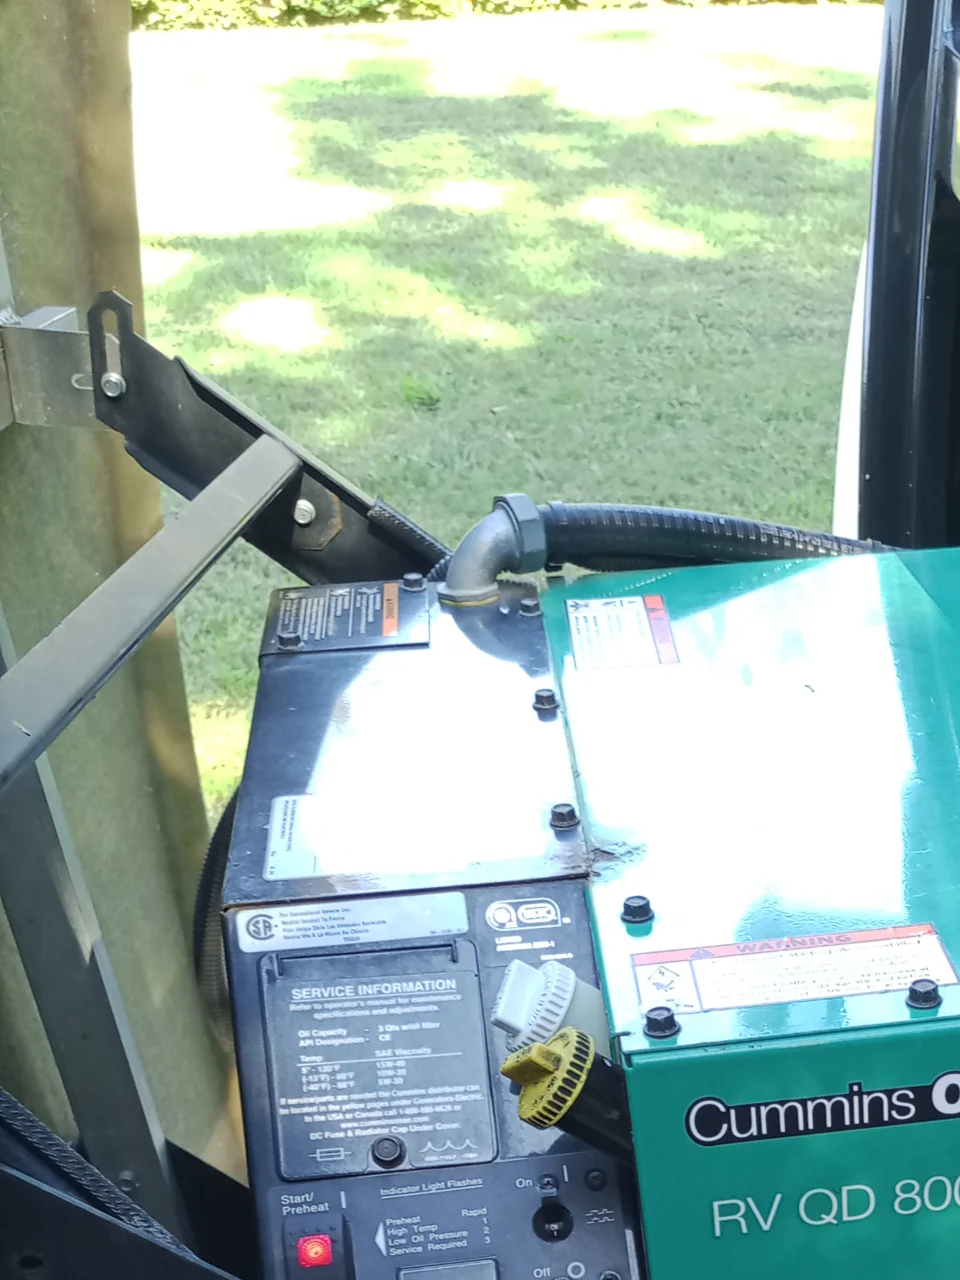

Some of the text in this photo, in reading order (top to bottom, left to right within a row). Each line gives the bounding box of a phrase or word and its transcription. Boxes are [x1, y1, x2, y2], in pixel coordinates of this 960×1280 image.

[736, 934, 852, 953] WARNING
[291, 979, 457, 1000] SERVICE INFORMATION
[289, 1003, 312, 1011] Refer
[323, 1000, 365, 1010] operator's
[366, 998, 397, 1006] manual
[410, 994, 462, 1003] maintenance
[313, 1009, 371, 1020] specifications
[371, 1007, 388, 1016] and
[298, 1029, 311, 1037] Oil
[311, 1028, 348, 1037] Capacity
[298, 1038, 314, 1047] API
[315, 1036, 365, 1046] Designation
[378, 1033, 392, 1041] CE
[299, 1046, 433, 1063] Temp SAE Viscosity
[391, 1088, 427, 1097] Cummins
[427, 1086, 465, 1095] distributor
[290, 1105, 319, 1114] located
[341, 1102, 366, 1112] yellow
[687, 1084, 916, 1143] Cummins
[327, 1112, 344, 1121] USA
[354, 1110, 384, 1119] Canada
[309, 1132, 324, 1140] DC
[324, 1131, 346, 1139] Fuse
[354, 1126, 390, 1137] Radiator
[391, 1125, 409, 1134] Cap
[409, 1124, 434, 1132] Under
[435, 1122, 462, 1130] Cover.
[380, 1177, 483, 1196] Indicator Light Flashes
[515, 1178, 533, 1189] On
[280, 1191, 314, 1205] Start/
[282, 1202, 330, 1216] Preheat
[461, 1207, 487, 1218] Rapid
[711, 1193, 782, 1237] RV
[799, 1184, 876, 1226] QD
[386, 1216, 421, 1226] Preheat
[387, 1224, 490, 1237] High Temp 2
[388, 1230, 491, 1247] Low Oil Pressure 3
[389, 1240, 468, 1257] Service Required
[533, 1267, 551, 1279] Off
